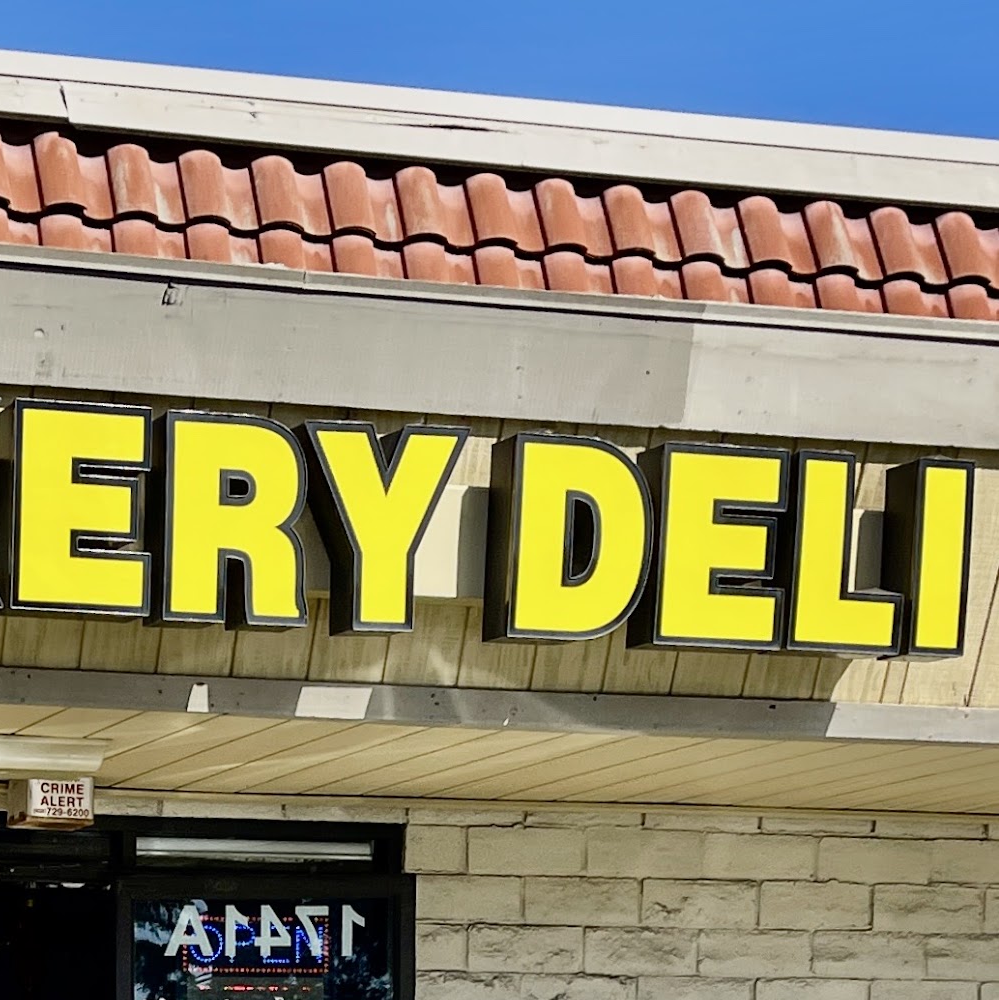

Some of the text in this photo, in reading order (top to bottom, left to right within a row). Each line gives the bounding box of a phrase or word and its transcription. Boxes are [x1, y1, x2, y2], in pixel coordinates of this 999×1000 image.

[505, 430, 976, 658] DELI
[40, 782, 85, 795] CRIME
[40, 795, 84, 807] ALERT
